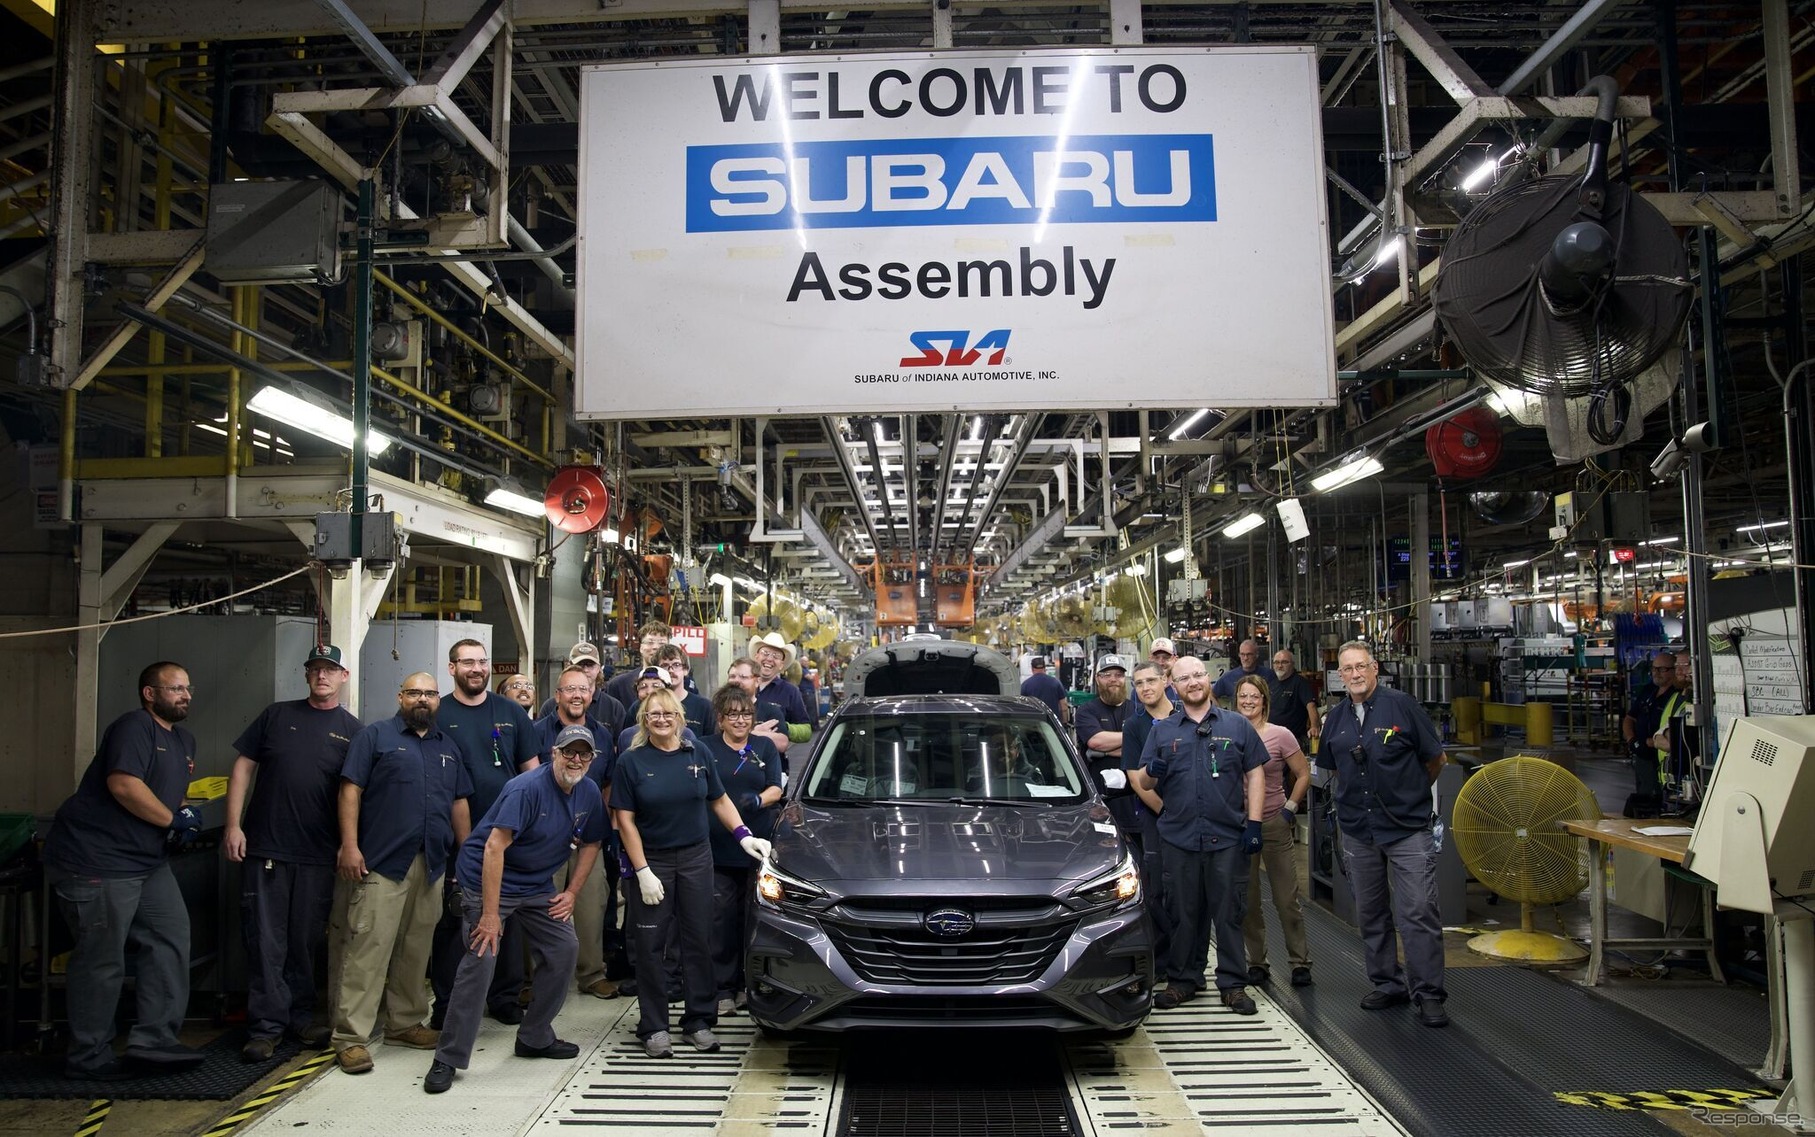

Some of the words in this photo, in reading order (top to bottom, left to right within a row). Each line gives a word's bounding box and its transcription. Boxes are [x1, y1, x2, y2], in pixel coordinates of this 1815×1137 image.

[712, 67, 1070, 122] WELCOME
[1094, 63, 1187, 114] TO
[709, 149, 1192, 217] SUBARU
[786, 245, 1117, 309] Assembly
[854, 374, 900, 384] SUBARU
[902, 373, 912, 383] of
[914, 373, 959, 382] INDIANA
[962, 371, 1036, 382] AUTOMOTIVE,
[1038, 370, 1060, 380] INC.
[673, 626, 704, 638] PILL
[498, 664, 517, 673] DAN
